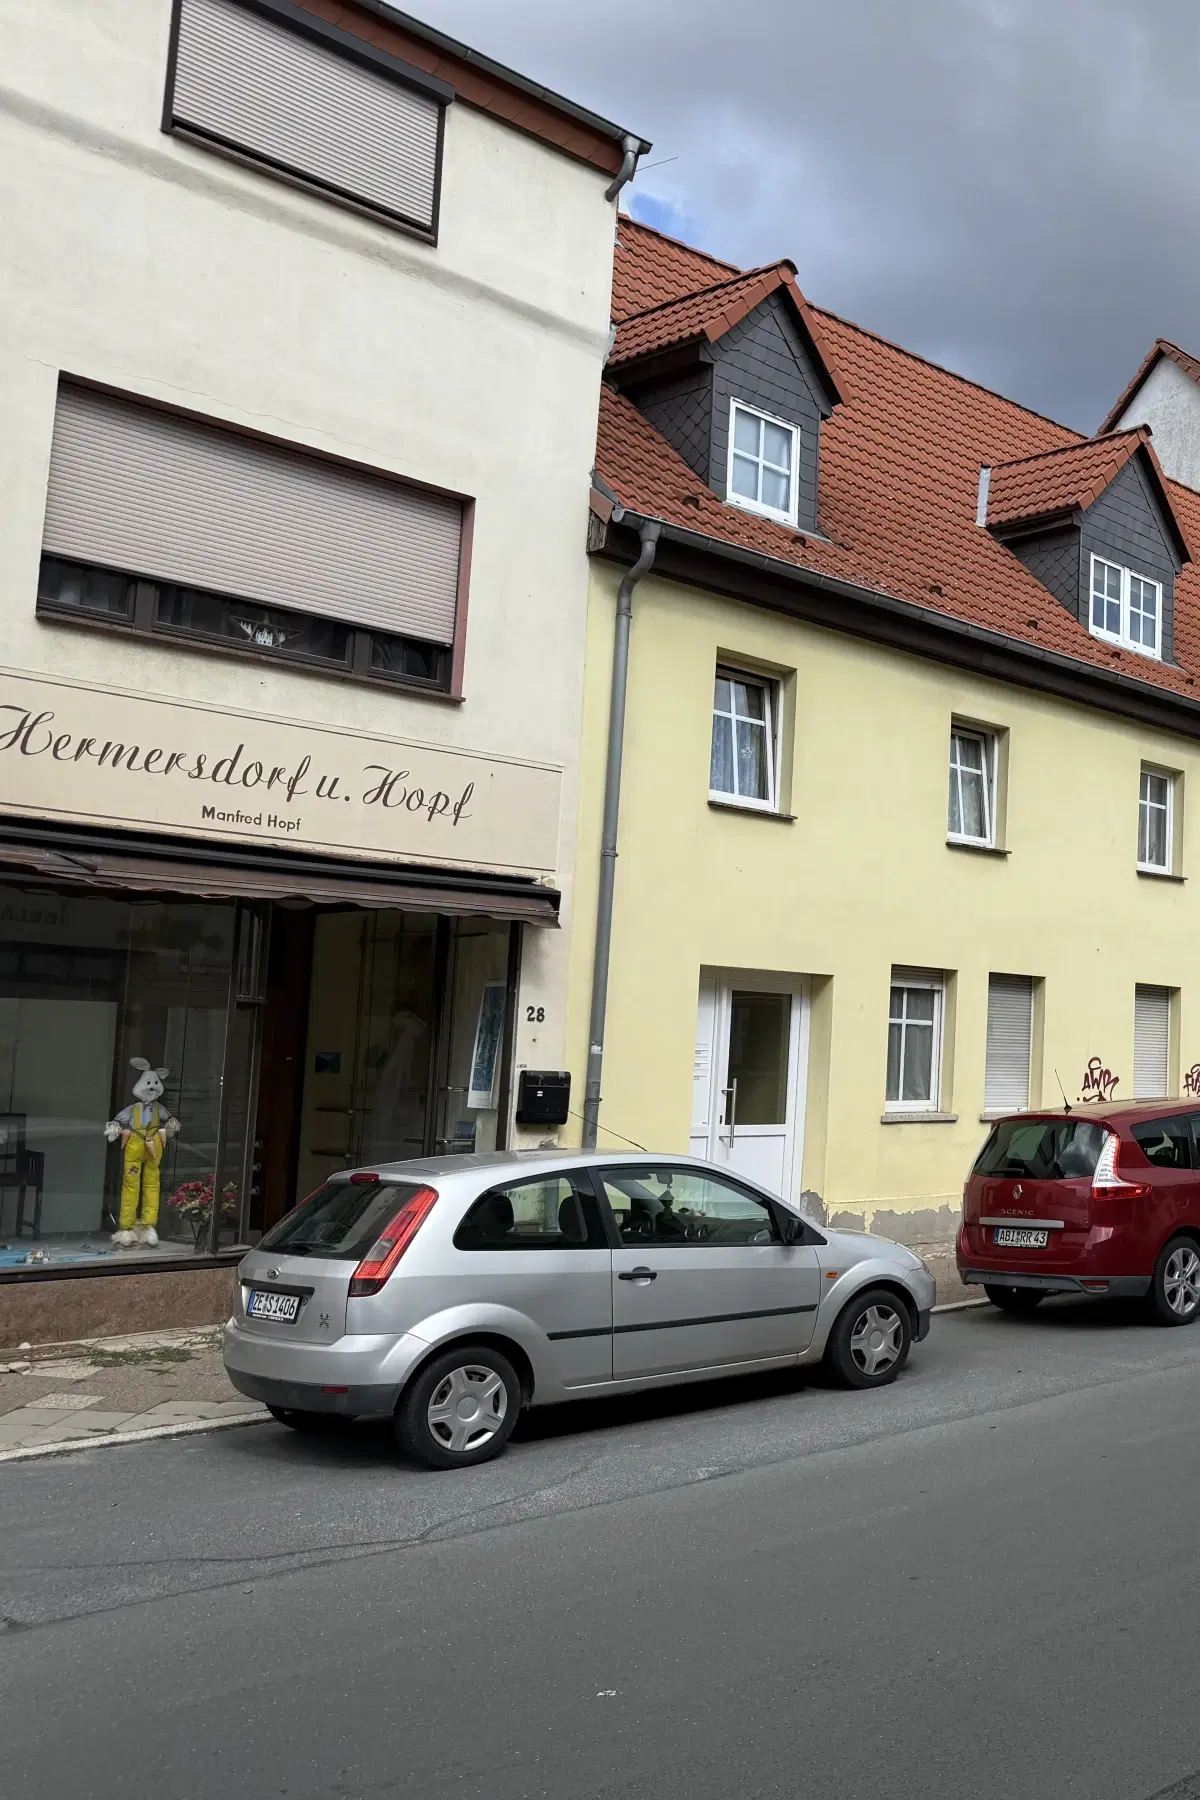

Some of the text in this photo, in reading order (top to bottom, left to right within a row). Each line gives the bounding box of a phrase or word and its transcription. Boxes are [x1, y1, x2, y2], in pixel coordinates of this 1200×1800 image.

[0, 705, 475, 826] Hermersdorf u. Hopf
[201, 805, 301, 832] Manfred Hopf
[526, 1005, 546, 1023] 28
[1001, 1208, 1035, 1216] SCENIC
[1000, 1230, 1046, 1244] ABI RR 43
